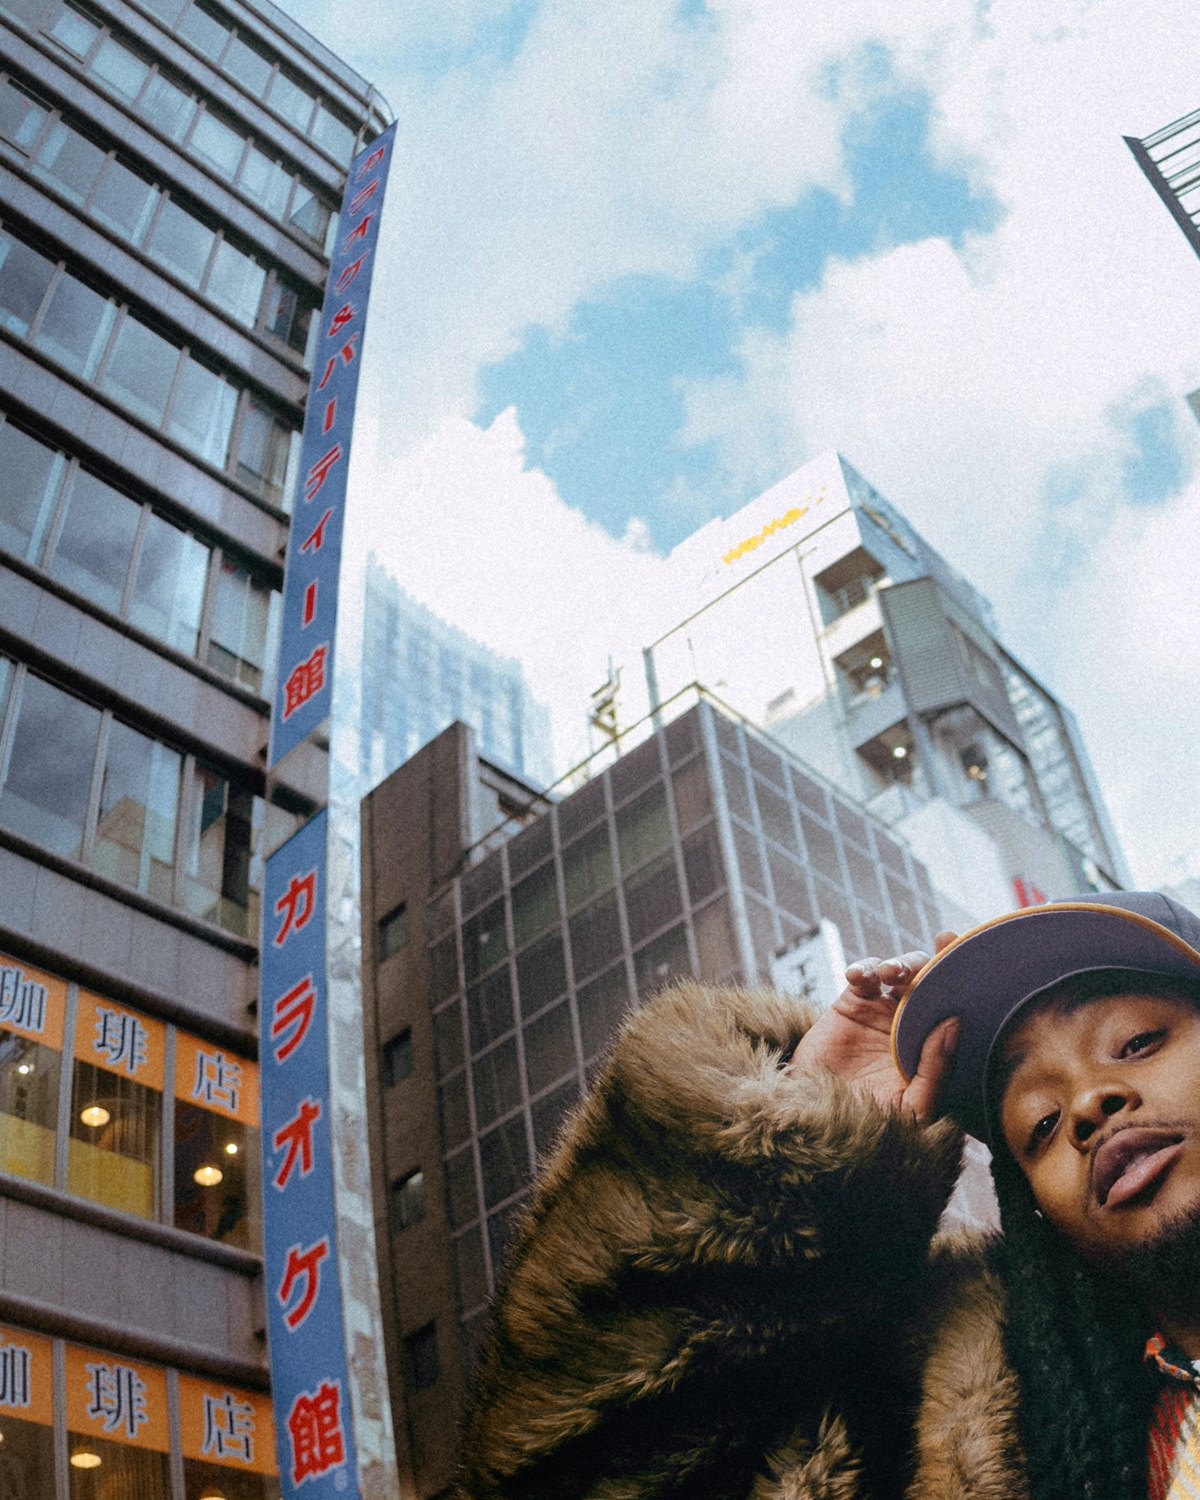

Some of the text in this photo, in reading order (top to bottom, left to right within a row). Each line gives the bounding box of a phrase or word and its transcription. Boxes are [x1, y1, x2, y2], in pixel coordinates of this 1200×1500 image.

[271, 868, 346, 1487] カラオケ館
